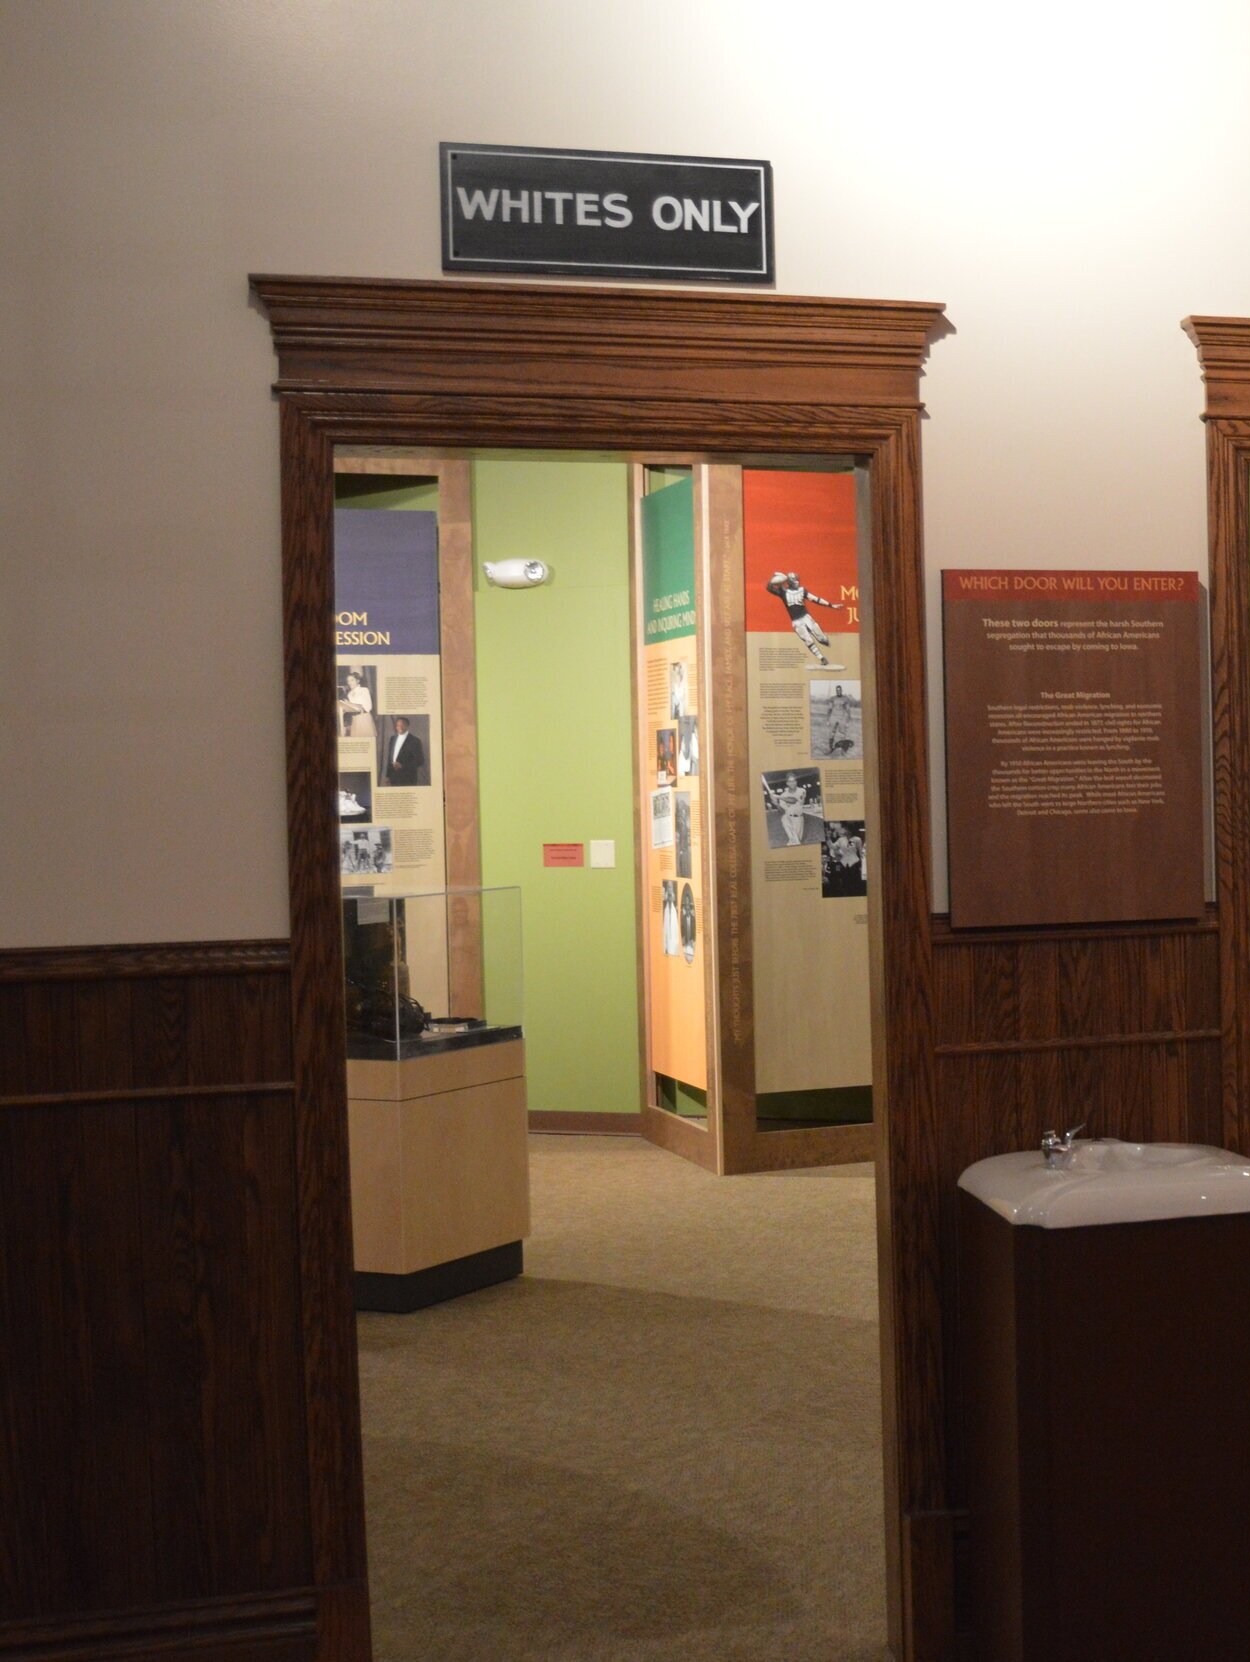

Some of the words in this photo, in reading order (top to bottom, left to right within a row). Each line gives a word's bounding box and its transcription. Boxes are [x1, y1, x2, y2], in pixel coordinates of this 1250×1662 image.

[457, 187, 632, 228] WHITES
[652, 197, 759, 233] ONLY
[960, 577, 1008, 590] WHICH
[1014, 577, 1058, 590] DOOR
[1063, 577, 1093, 590] WILL
[1097, 577, 1128, 590] YOU
[1134, 577, 1184, 591] ENTER?
[673, 591, 689, 608] HANDS
[648, 620, 657, 634] AND
[982, 619, 1010, 627] These
[1032, 619, 1058, 627] doors
[1077, 692, 1110, 700] Migration
